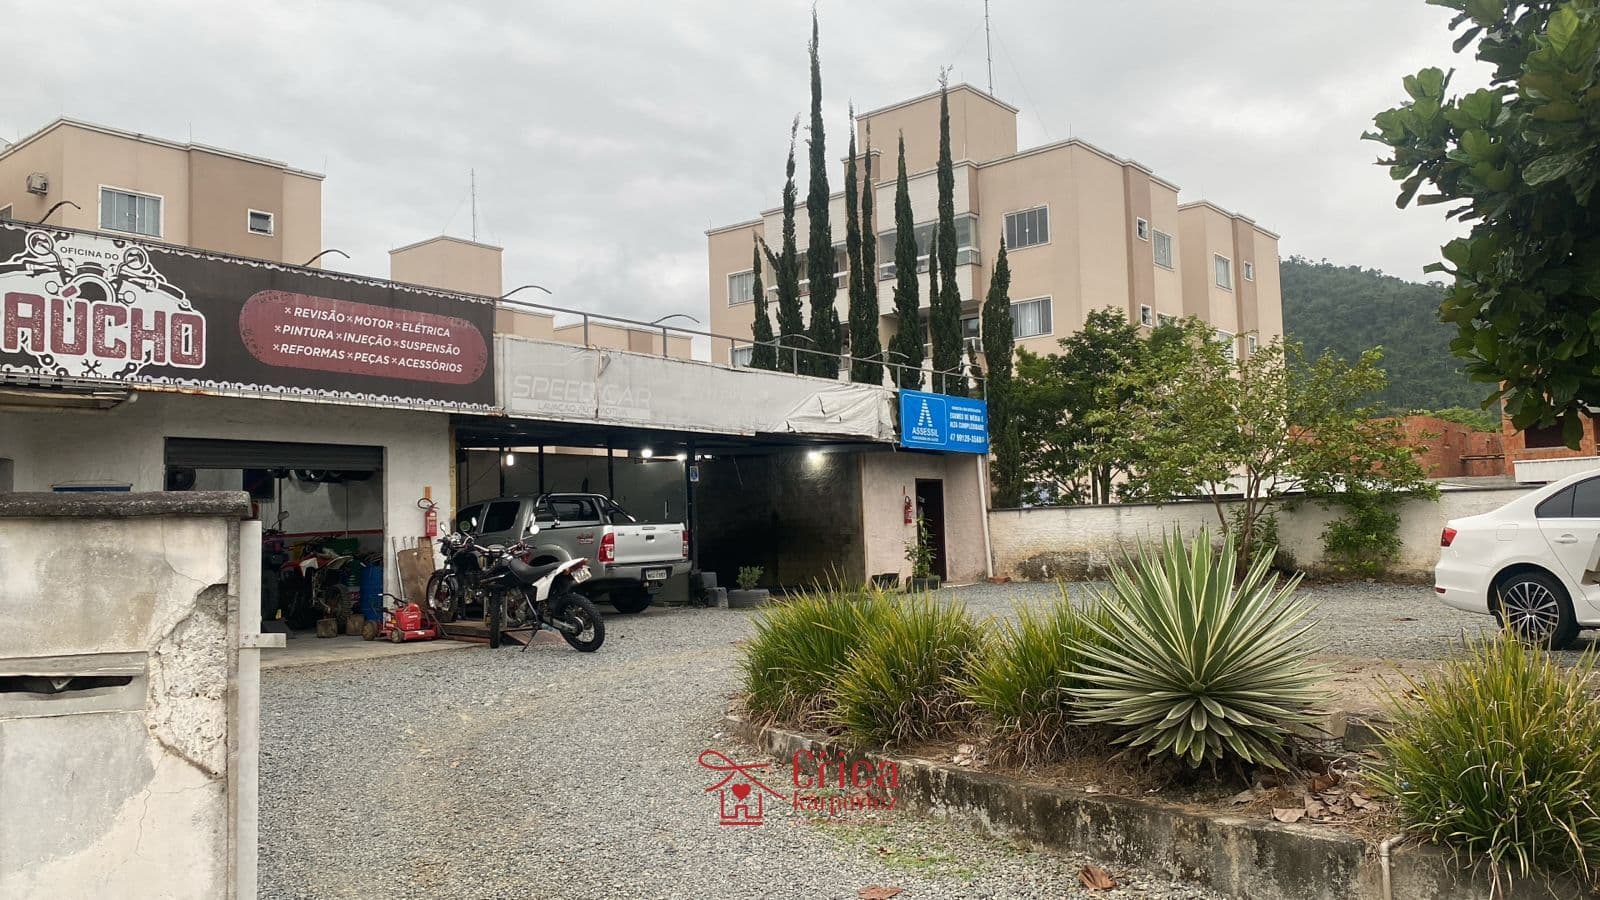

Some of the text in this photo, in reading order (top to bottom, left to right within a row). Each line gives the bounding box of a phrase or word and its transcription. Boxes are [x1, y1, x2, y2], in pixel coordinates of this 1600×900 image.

[60, 245, 119, 261] OFICINA DO
[294, 307, 451, 338] REVISÃO MOTOR ELÉTRICA
[282, 325, 461, 356] PINTURA INJEÇÃO SUSPENSÃO
[280, 344, 463, 373] REFORMAS PEÇAS ACESSÓRIOS
